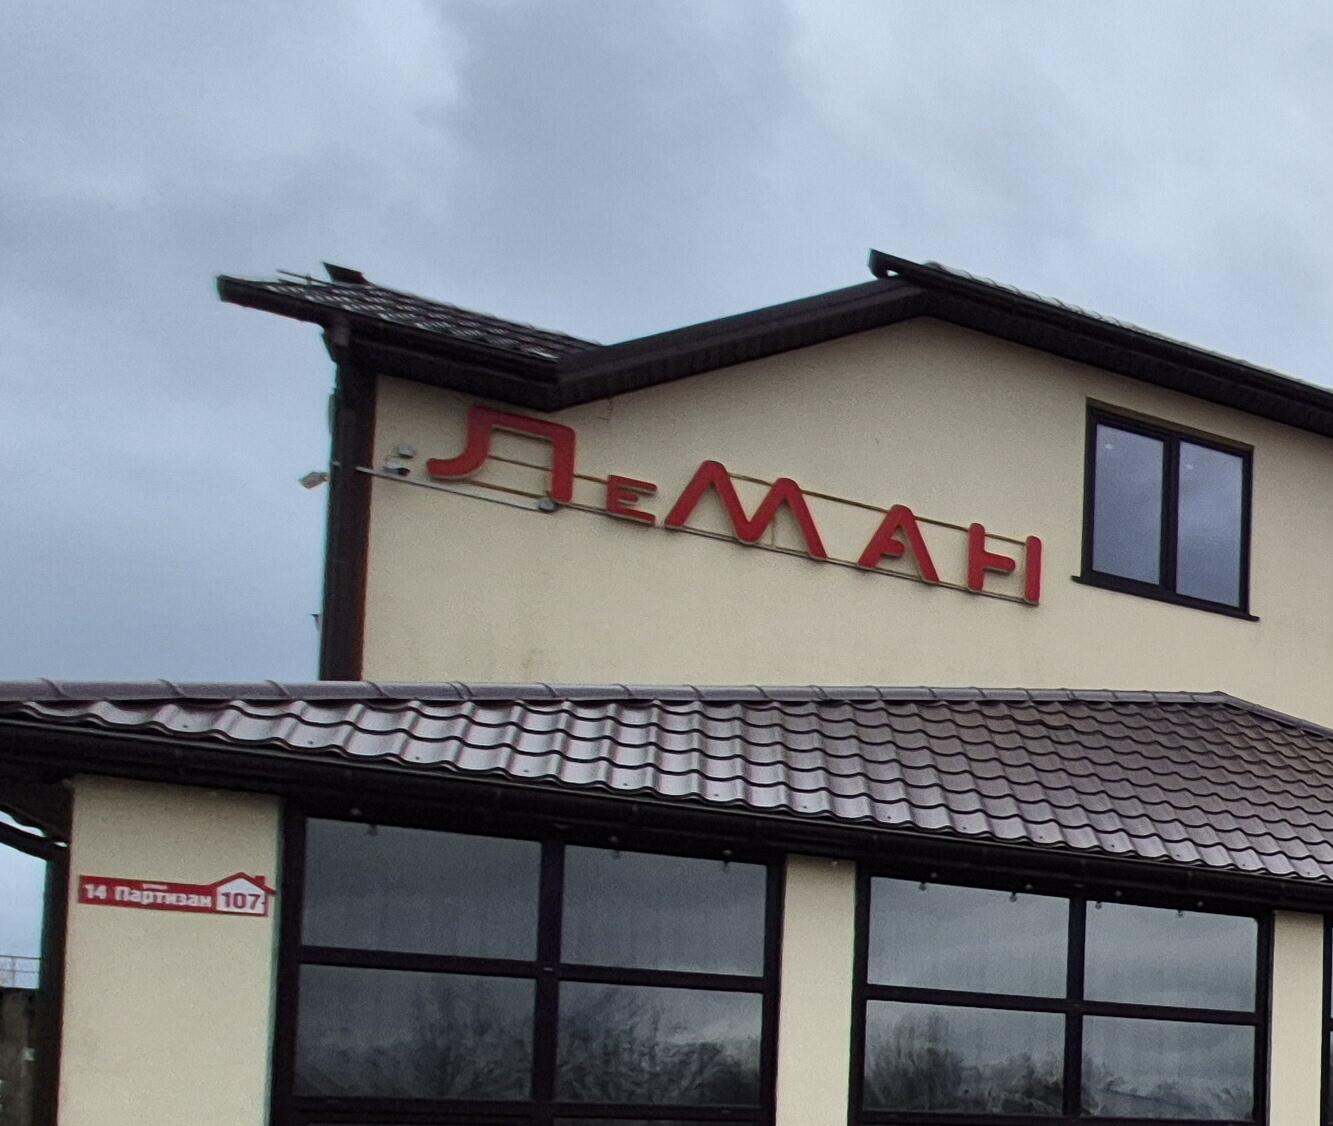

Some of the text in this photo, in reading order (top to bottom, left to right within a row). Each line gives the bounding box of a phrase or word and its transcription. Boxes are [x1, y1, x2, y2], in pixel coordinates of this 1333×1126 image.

[84, 883, 261, 911] 14 Партизан 107
